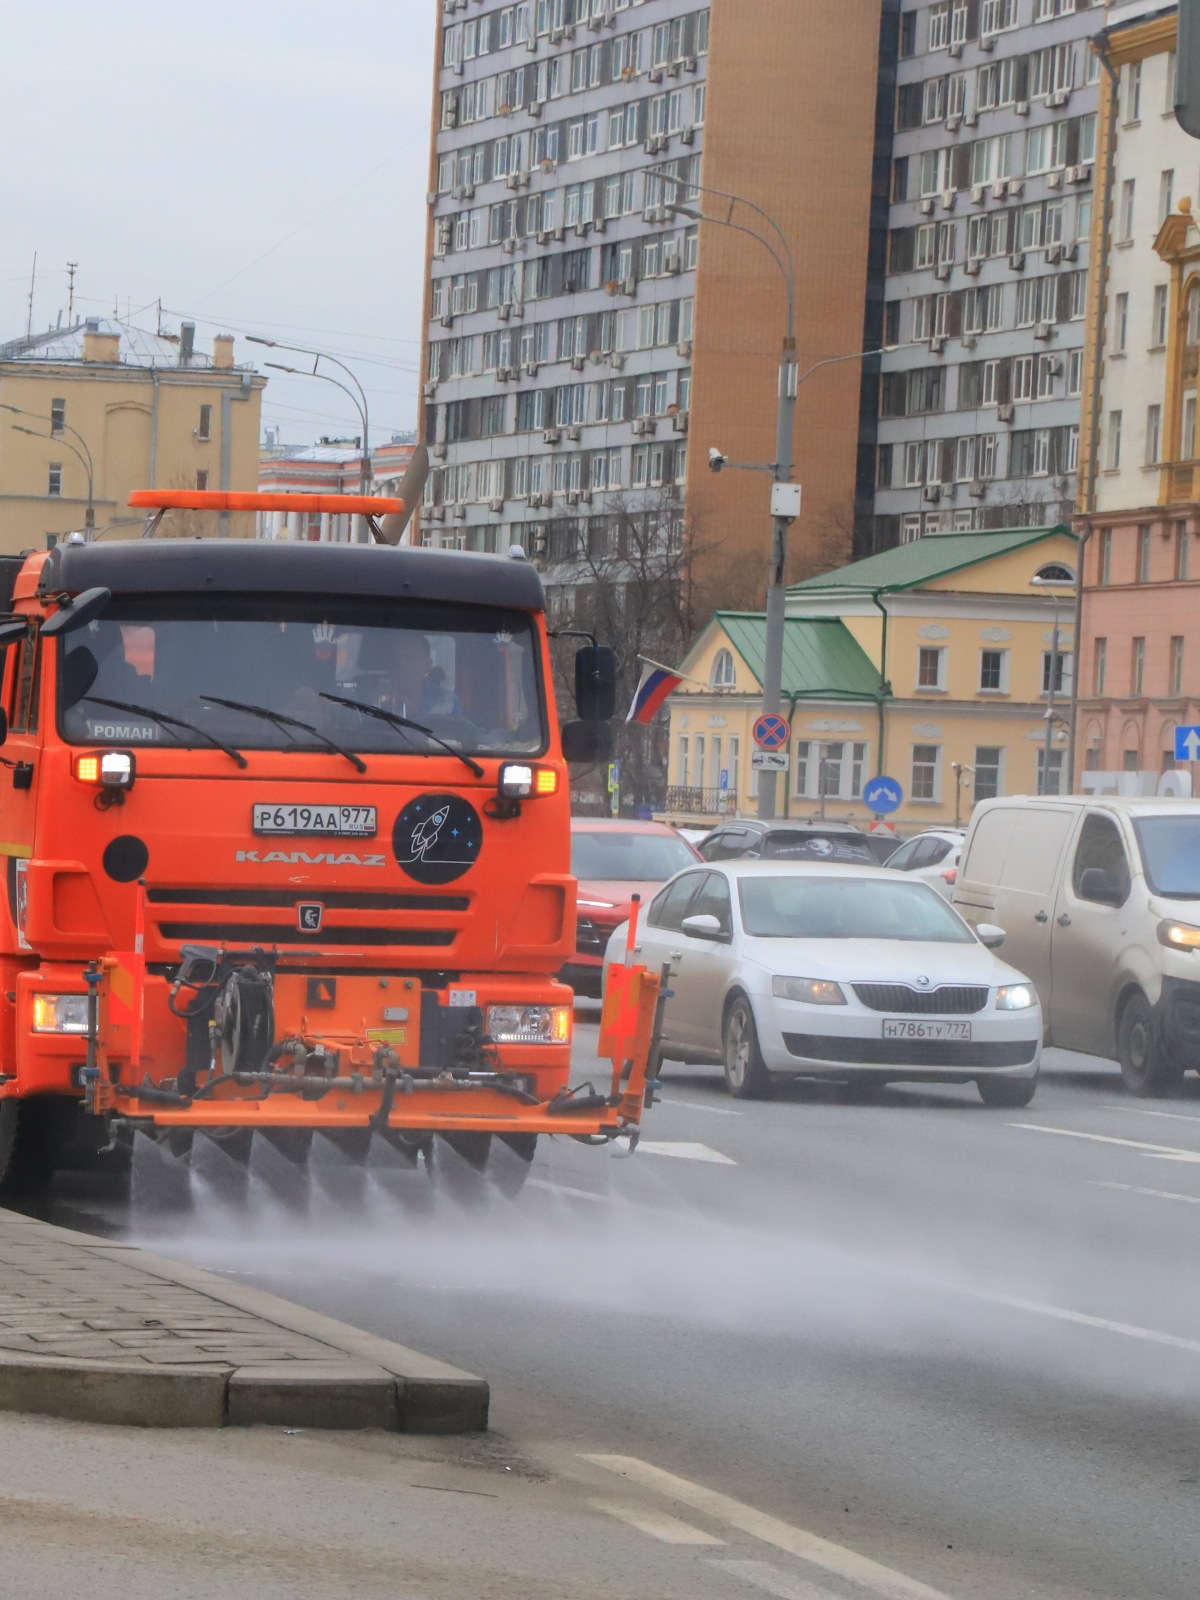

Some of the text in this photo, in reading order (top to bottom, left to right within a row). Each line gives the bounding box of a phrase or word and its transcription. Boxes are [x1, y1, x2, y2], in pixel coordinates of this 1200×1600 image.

[94, 725, 153, 740] РОМАН
[341, 807, 371, 823] 977
[236, 850, 385, 867] KAMAZ
